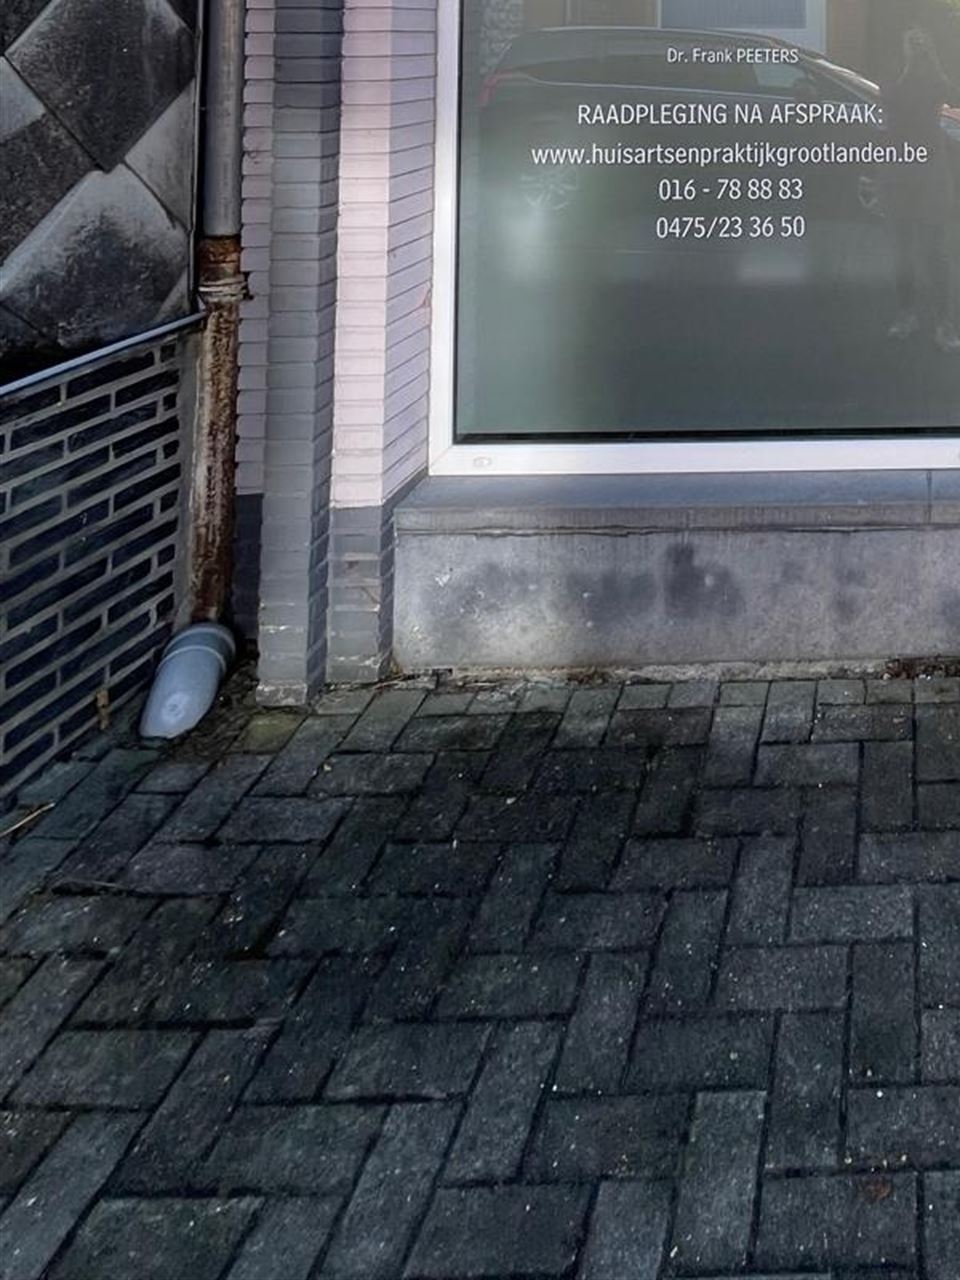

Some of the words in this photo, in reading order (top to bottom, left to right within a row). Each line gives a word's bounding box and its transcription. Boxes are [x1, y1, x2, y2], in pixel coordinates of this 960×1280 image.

[667, 48, 688, 63] Dr.
[692, 48, 733, 63] Frank
[736, 48, 799, 64] PEETERS
[578, 103, 728, 125] RAADPLEGING
[734, 103, 764, 125] NA
[769, 103, 883, 125] AFSPRAAK:
[531, 142, 928, 167] www.huisartsenpraktijkgrootlanden.be
[658, 178, 696, 201] 016
[716, 178, 742, 200] 78
[747, 178, 773, 200] 88
[778, 178, 804, 200] 83
[656, 216, 743, 239] 0475/23
[749, 216, 775, 238] 36
[780, 216, 806, 238] 50
